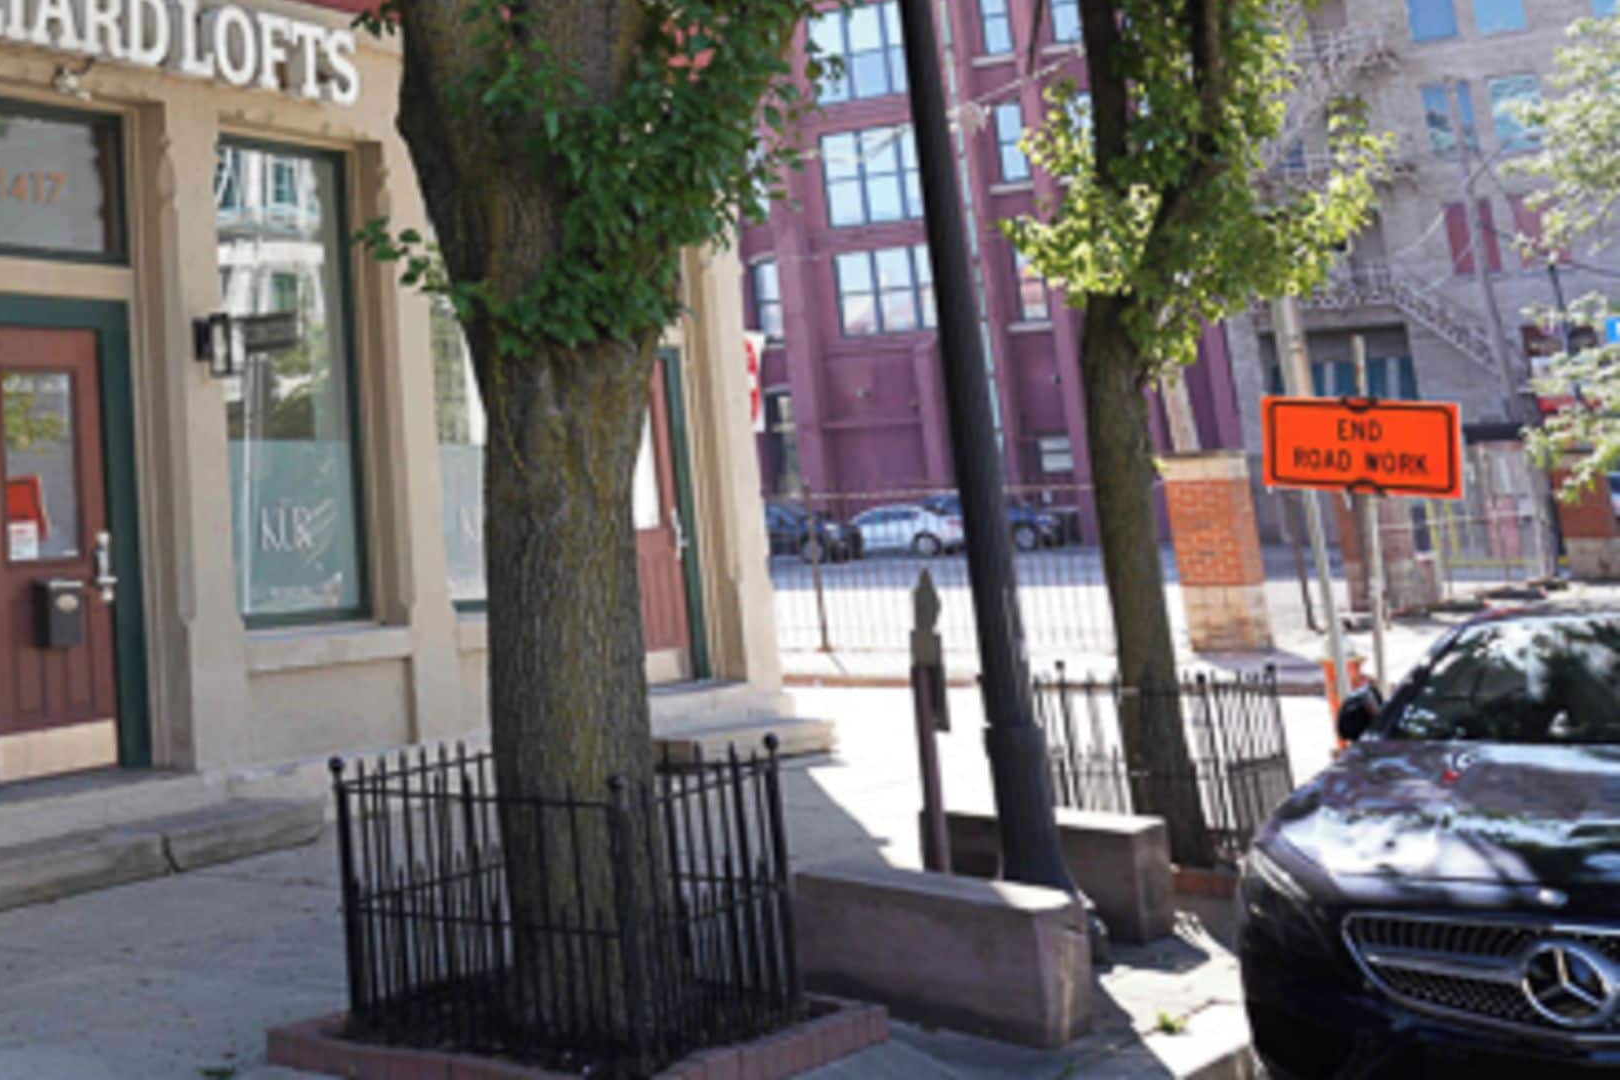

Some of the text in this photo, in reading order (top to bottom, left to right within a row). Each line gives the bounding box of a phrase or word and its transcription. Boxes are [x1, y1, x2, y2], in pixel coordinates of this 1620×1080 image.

[1336, 418, 1383, 441] END
[1293, 446, 1429, 476] ROAD WORK
